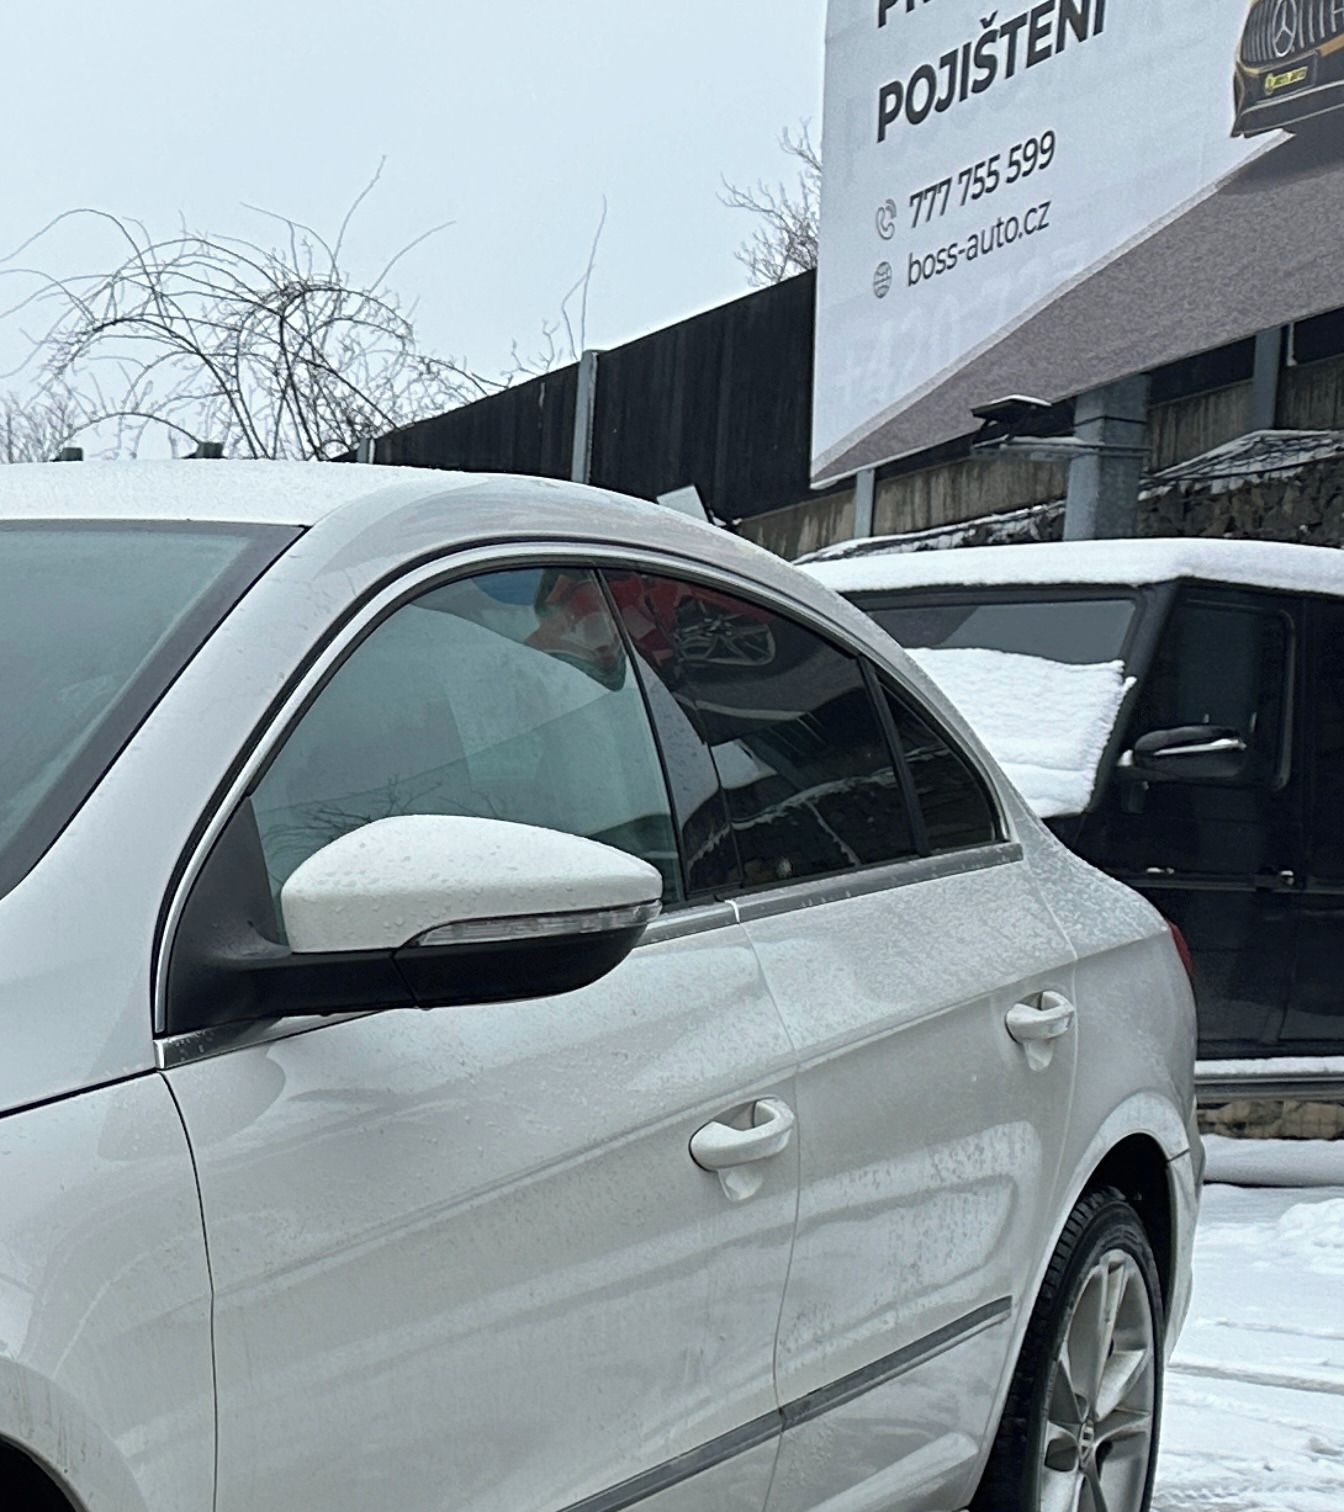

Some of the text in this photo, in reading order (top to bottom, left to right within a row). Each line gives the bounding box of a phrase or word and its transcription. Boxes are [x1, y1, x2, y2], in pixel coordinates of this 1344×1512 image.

[909, 129, 1056, 229] 777 755 599
[907, 200, 1052, 287] boss-auto.cz
